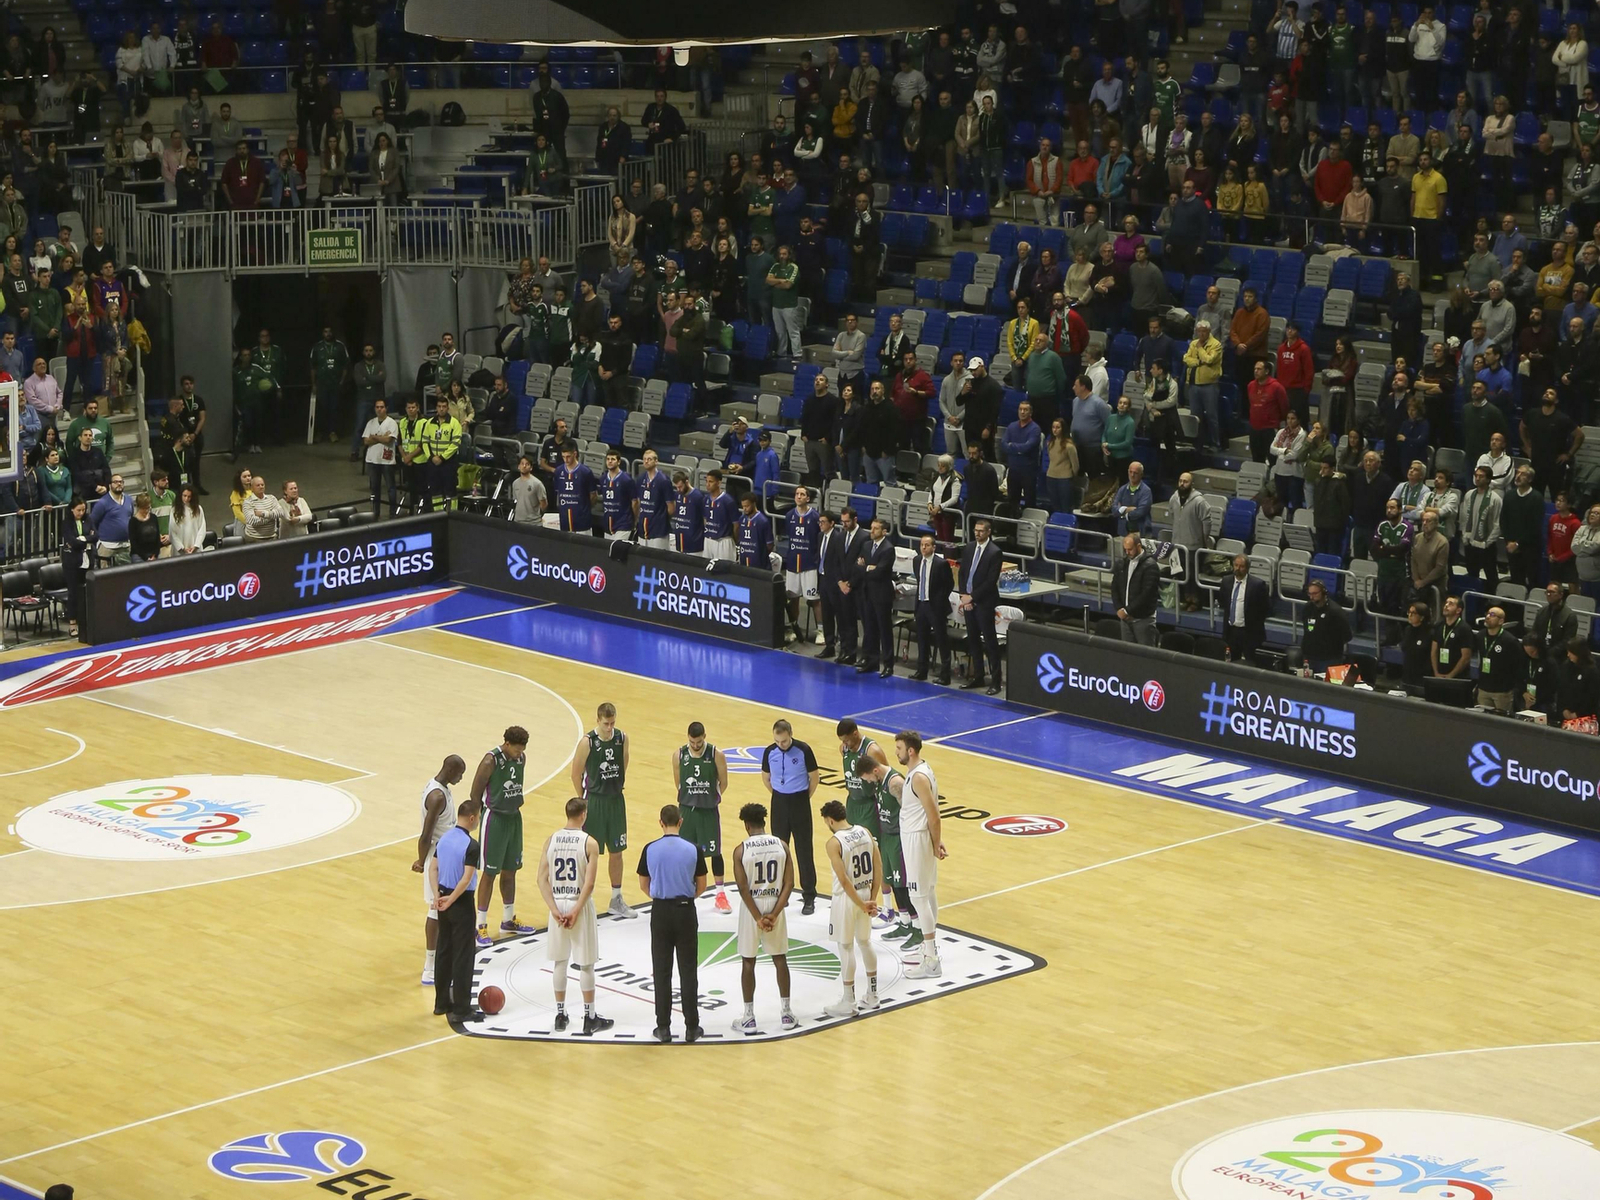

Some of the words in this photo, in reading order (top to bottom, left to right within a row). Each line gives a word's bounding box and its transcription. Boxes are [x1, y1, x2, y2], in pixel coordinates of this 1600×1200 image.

[311, 248, 357, 260] EMERGENCIA
[313, 236, 339, 248] SALIDA
[344, 236, 354, 247] DE
[565, 481, 574, 491] 15
[795, 526, 805, 536] 24
[323, 552, 434, 590] GREATNESS
[531, 557, 587, 588] EuroCup
[161, 582, 237, 611] EuroCup
[656, 591, 751, 628] GREATNESS
[95, 633, 266, 681] TURKISH
[254, 604, 426, 652] AIRLINES
[1068, 667, 1141, 704] EuroCup
[1229, 712, 1357, 759] GREATNESS
[605, 748, 614, 761] 52
[510, 766, 517, 779] 2
[694, 765, 700, 777] 3
[1507, 760, 1595, 801] EuroCup
[1111, 752, 1579, 865] MALAGA
[48, 809, 108, 830] EUROPEAN
[104, 824, 144, 840] CAPITAL
[161, 841, 202, 855] SPORT
[556, 836, 580, 845] WALKER
[1005, 822, 1062, 835] DAYS
[709, 840, 716, 852] 3
[554, 857, 577, 882] 23
[754, 859, 778, 885] 10
[852, 851, 872, 879] 30
